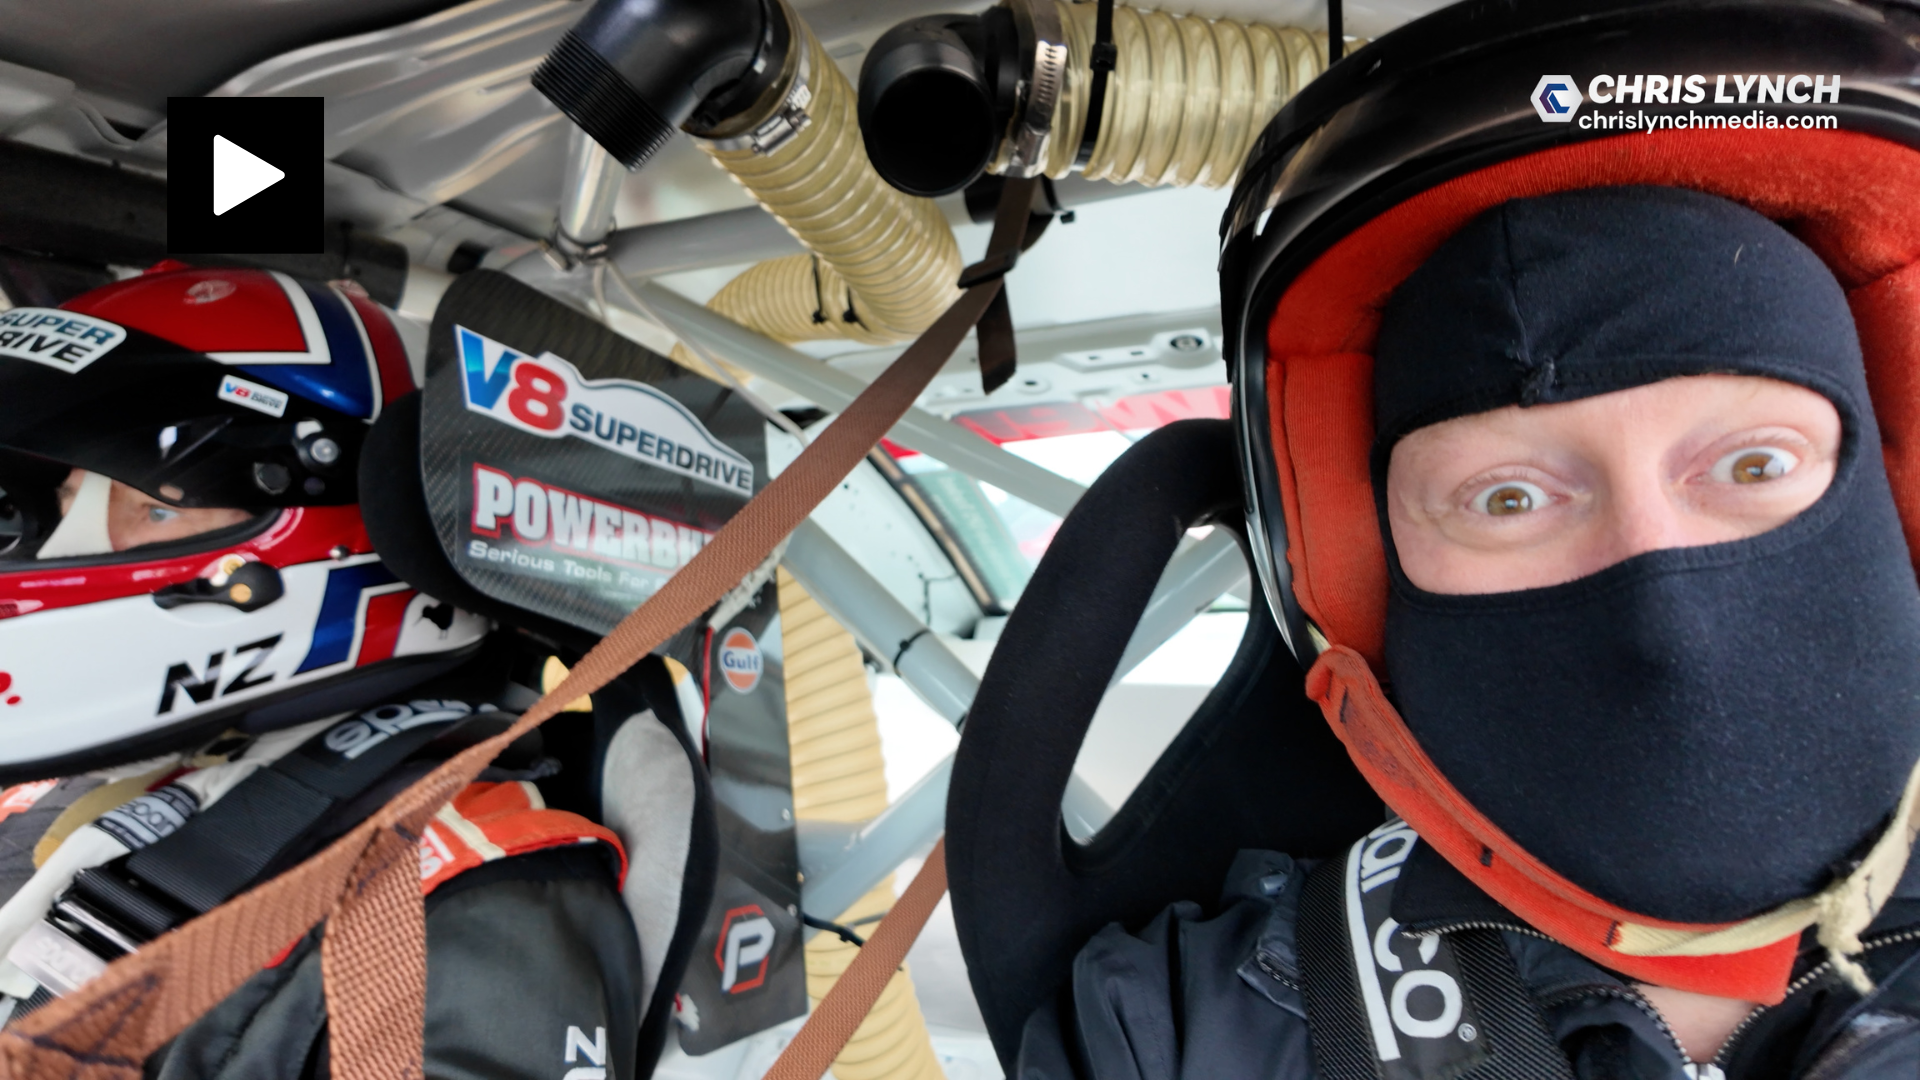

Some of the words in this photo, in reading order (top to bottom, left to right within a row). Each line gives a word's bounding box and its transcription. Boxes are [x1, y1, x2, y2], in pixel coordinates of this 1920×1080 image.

[0, 313, 116, 346] SUPER
[461, 329, 568, 432] V8
[569, 402, 752, 491] SUPERDRIVE
[469, 540, 555, 572] Serious
[563, 559, 612, 583] Tools
[156, 633, 284, 717] NZ
[723, 650, 759, 670] Gulf
